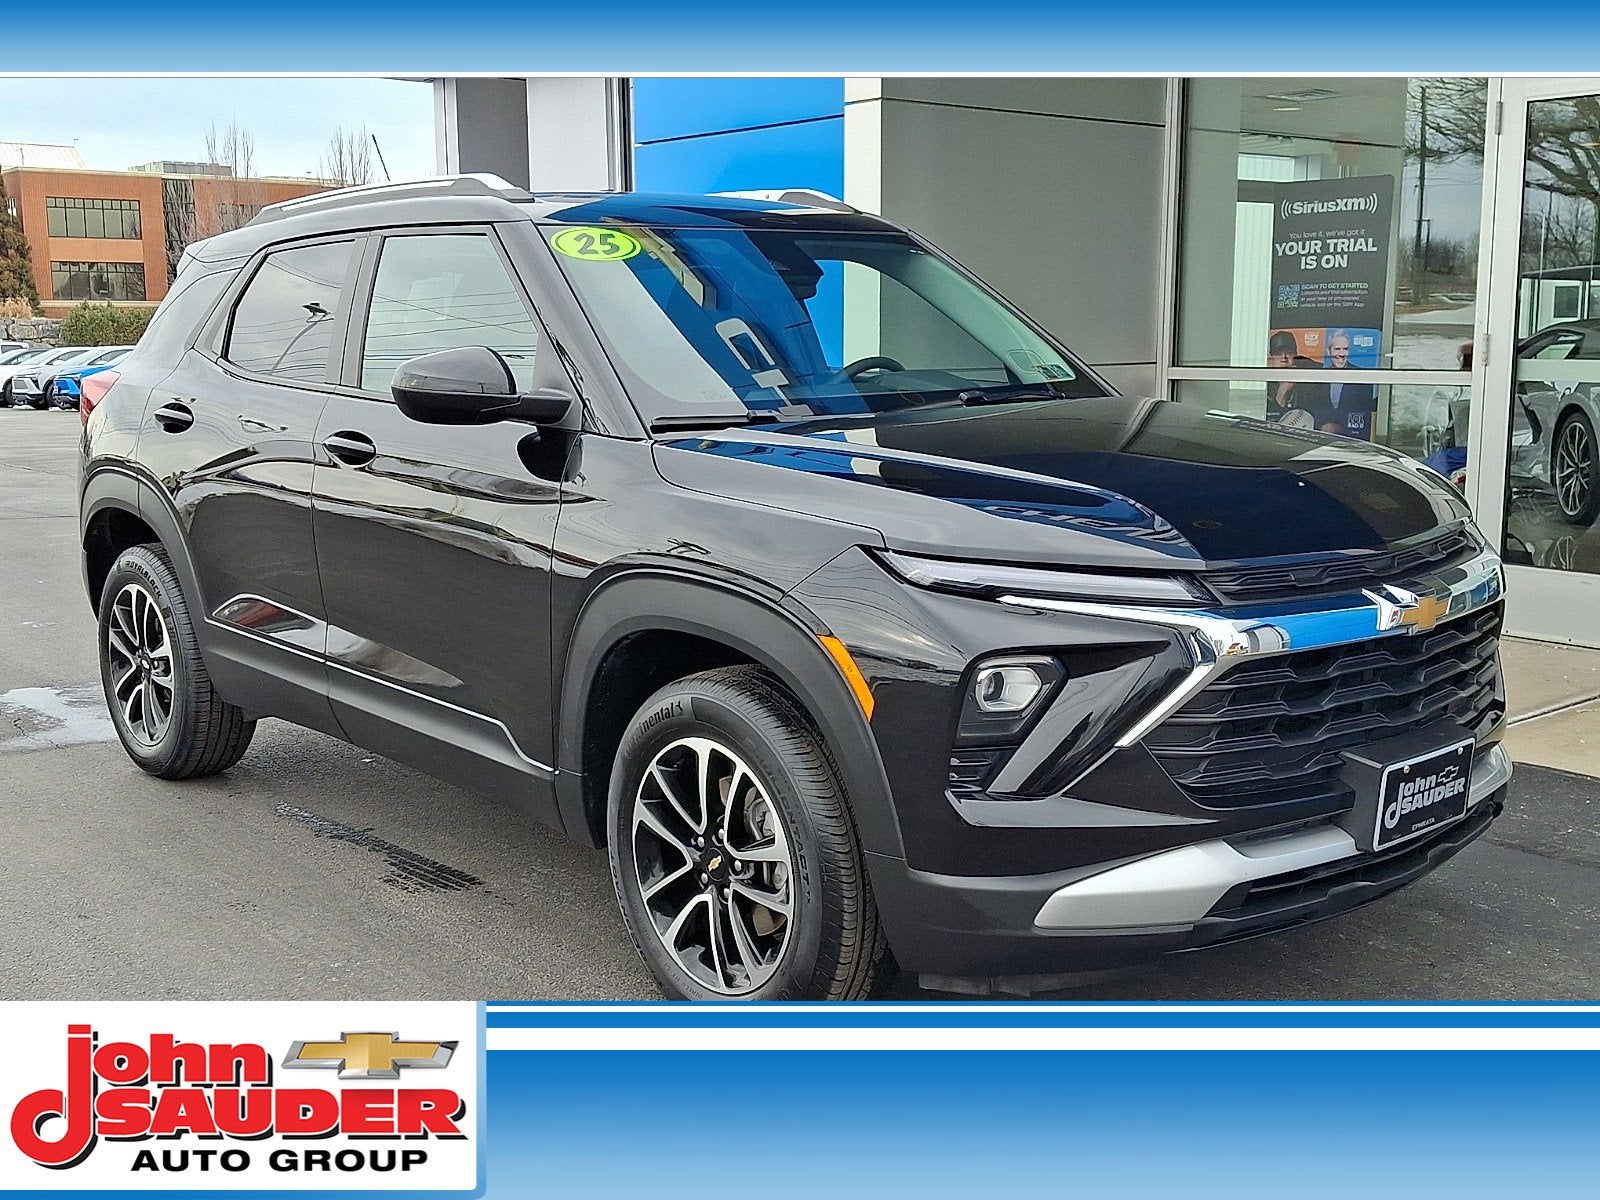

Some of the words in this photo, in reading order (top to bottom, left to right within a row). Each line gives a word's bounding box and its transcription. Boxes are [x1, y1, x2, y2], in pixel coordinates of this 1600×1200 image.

[574, 232, 620, 255] 25
[1275, 240, 1323, 256] YOUR
[1327, 237, 1378, 253] TRIAL
[1301, 255, 1318, 270] IS
[1321, 254, 1348, 269] ON
[1400, 776, 1466, 815] SAUDER
